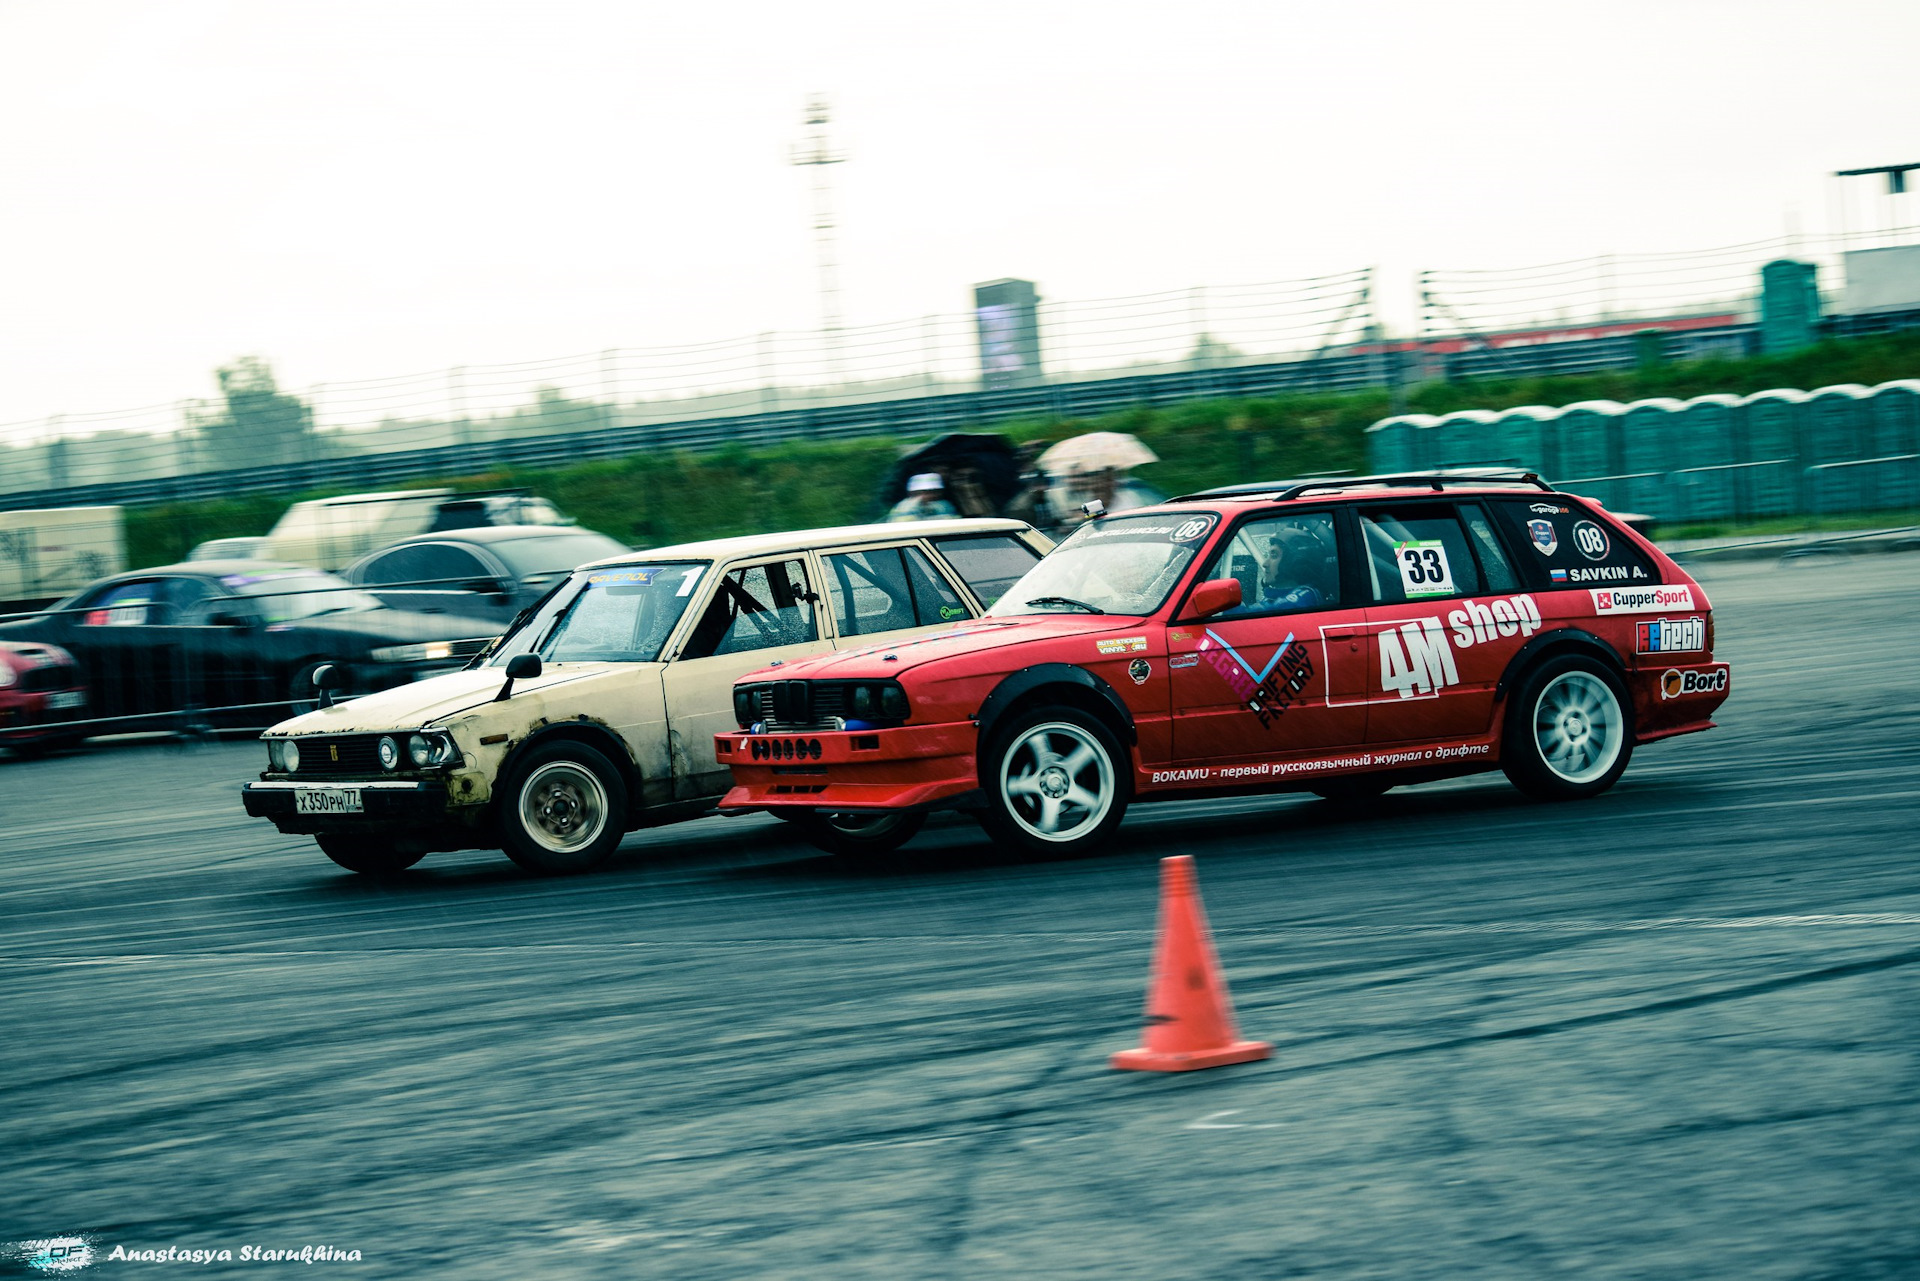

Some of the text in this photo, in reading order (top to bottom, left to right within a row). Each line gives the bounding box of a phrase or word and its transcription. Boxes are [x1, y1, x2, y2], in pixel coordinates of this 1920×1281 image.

[1174, 520, 1206, 538] 08
[1578, 527, 1605, 554] 08
[675, 565, 706, 597] 1
[1404, 549, 1445, 584] 33
[1569, 565, 1648, 582] SAVKIN A.
[1613, 589, 1689, 609] CupperSport
[1378, 593, 1542, 699] 4M shop
[1236, 641, 1308, 716] DRIFTING
[1683, 670, 1726, 692] Bort
[1259, 657, 1315, 730] FACTORY
[1220, 763, 1269, 779] первый
[1272, 754, 1371, 776] русскоязычный
[1374, 749, 1422, 766] журнал
[1425, 750, 1433, 759] о
[1435, 744, 1490, 759] дрифте
[344, 790, 357, 805] 77
